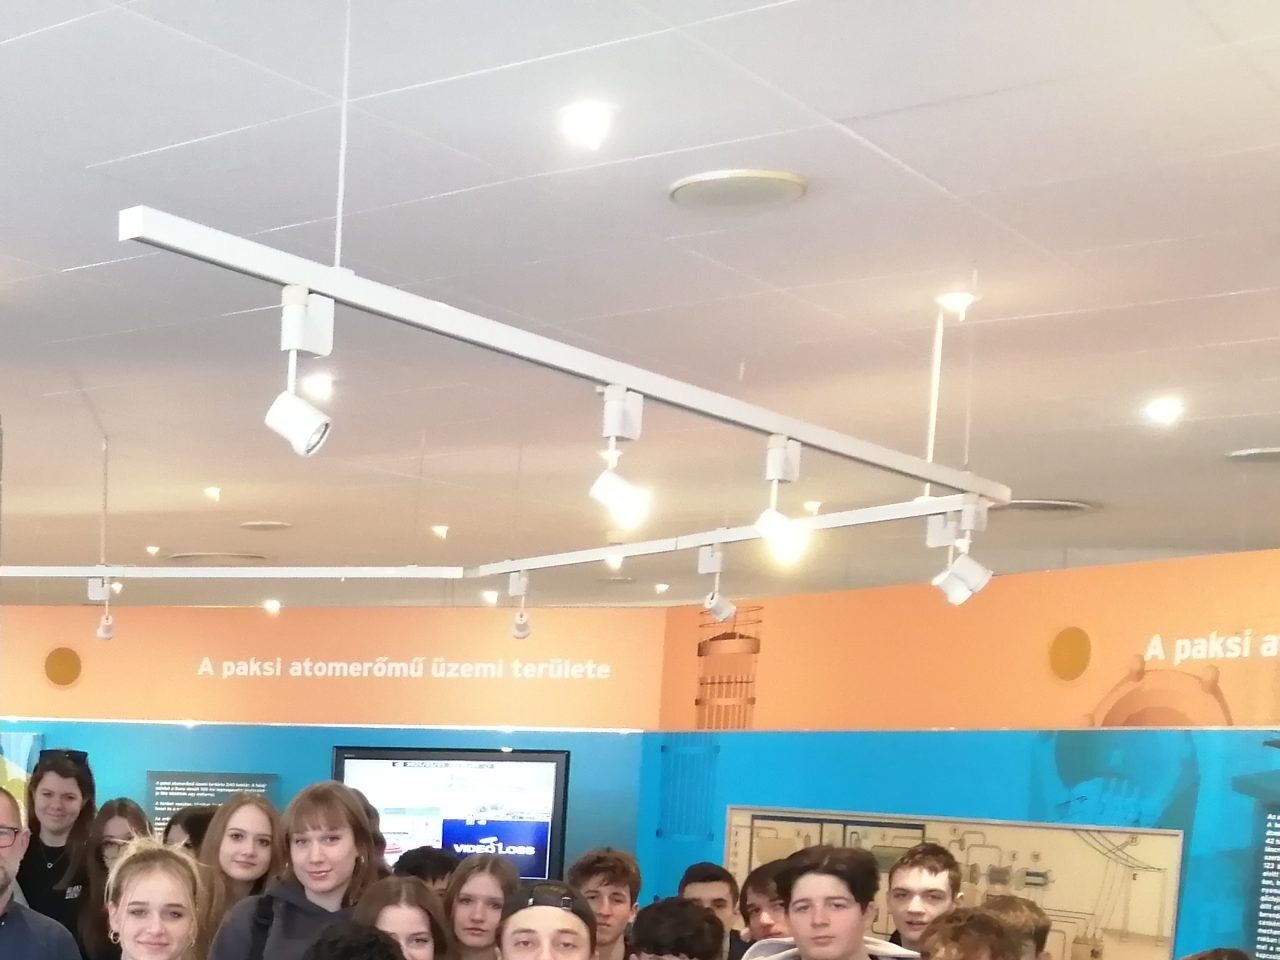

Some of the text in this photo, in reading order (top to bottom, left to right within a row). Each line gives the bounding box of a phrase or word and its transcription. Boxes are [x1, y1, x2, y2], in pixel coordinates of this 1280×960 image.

[1144, 629, 1280, 666] A paksi a
[197, 656, 611, 680] A paksi atomerőmű üzemi területe
